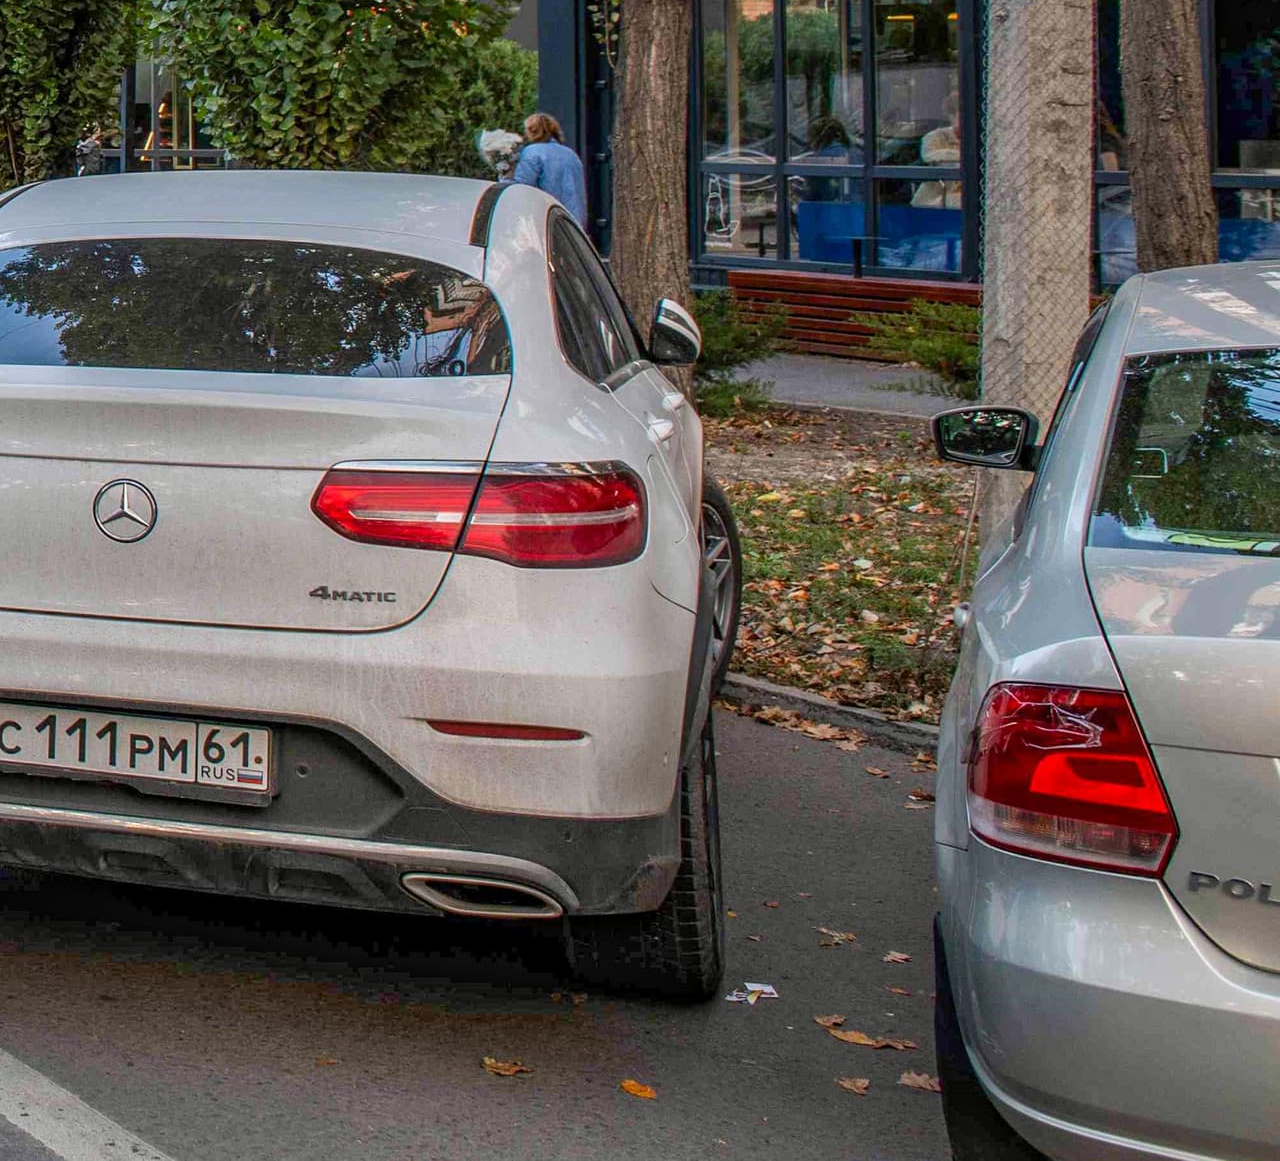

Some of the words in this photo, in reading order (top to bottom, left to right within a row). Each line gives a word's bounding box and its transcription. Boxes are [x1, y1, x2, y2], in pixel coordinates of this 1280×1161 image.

[309, 585, 397, 603] 4MATIC
[203, 728, 250, 768] 61
[200, 765, 236, 781] RUS
